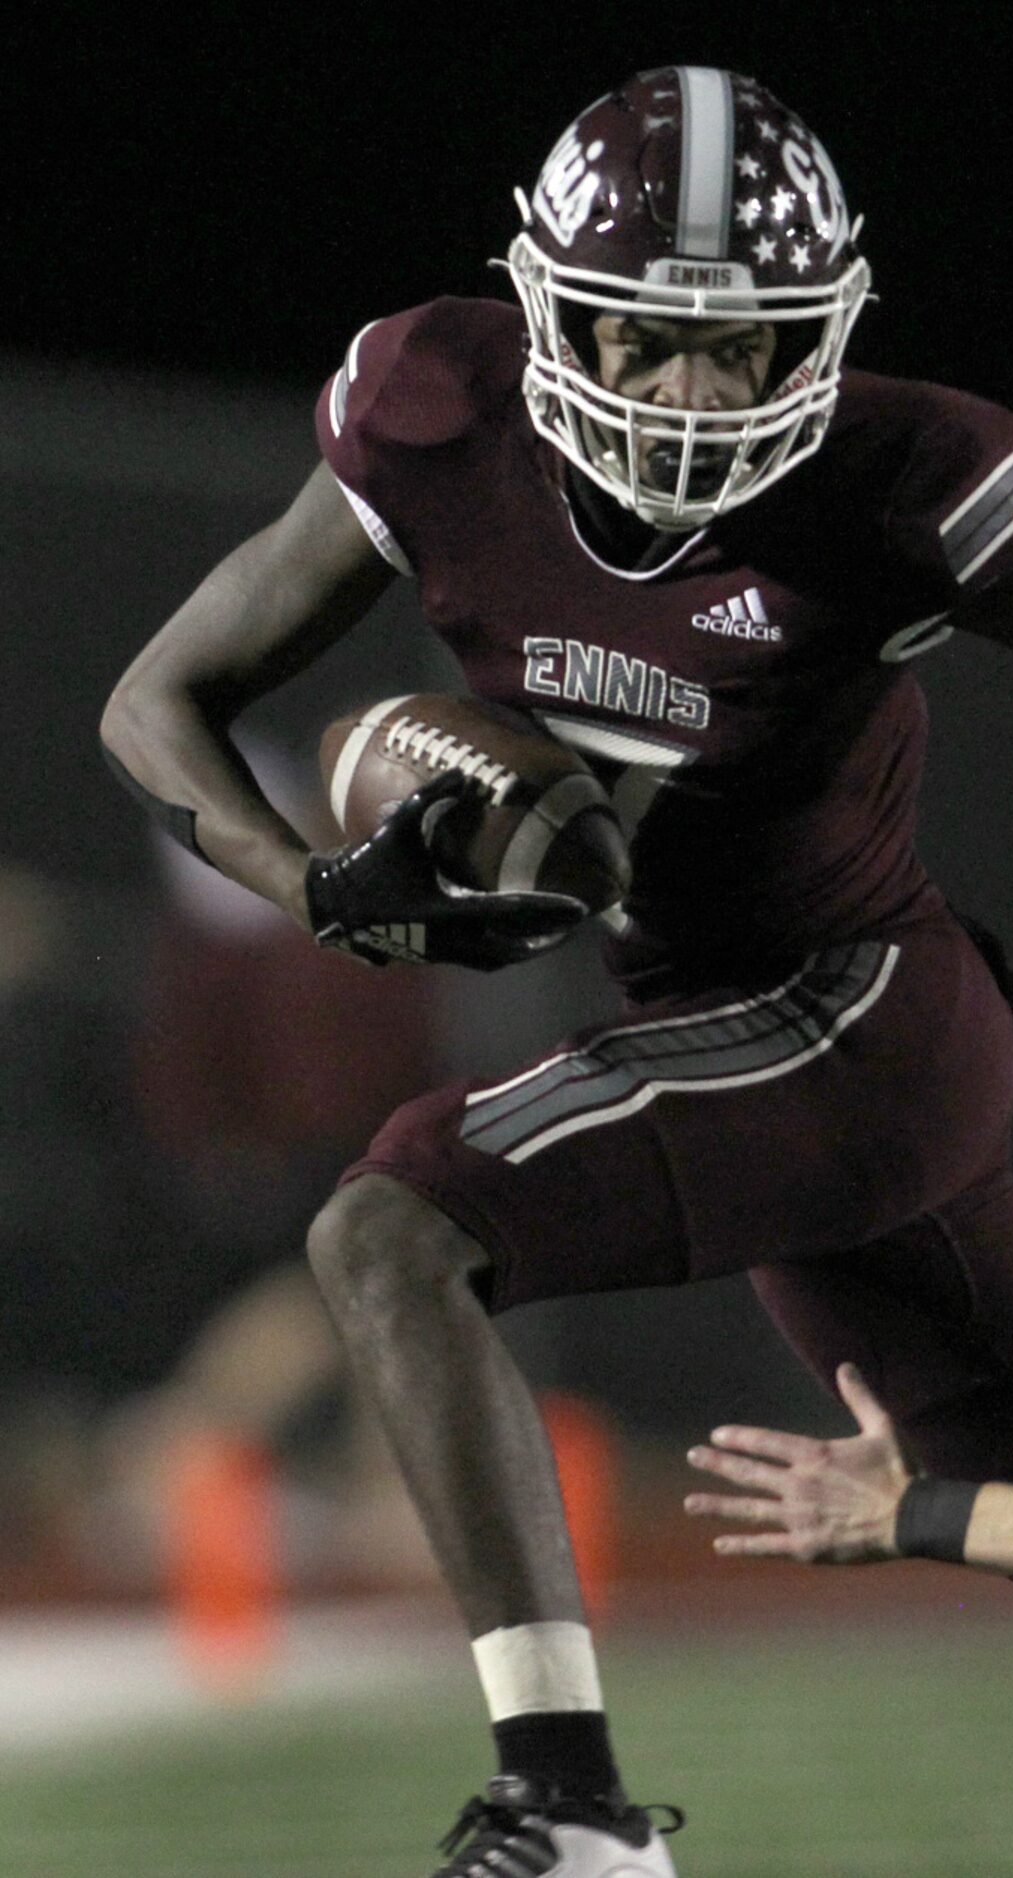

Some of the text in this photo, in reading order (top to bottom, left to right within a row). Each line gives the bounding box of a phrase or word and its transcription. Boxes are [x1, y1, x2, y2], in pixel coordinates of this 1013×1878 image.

[667, 264, 732, 287] ENNIS
[691, 613, 783, 642] adidas
[523, 636, 710, 730] ENNIS
